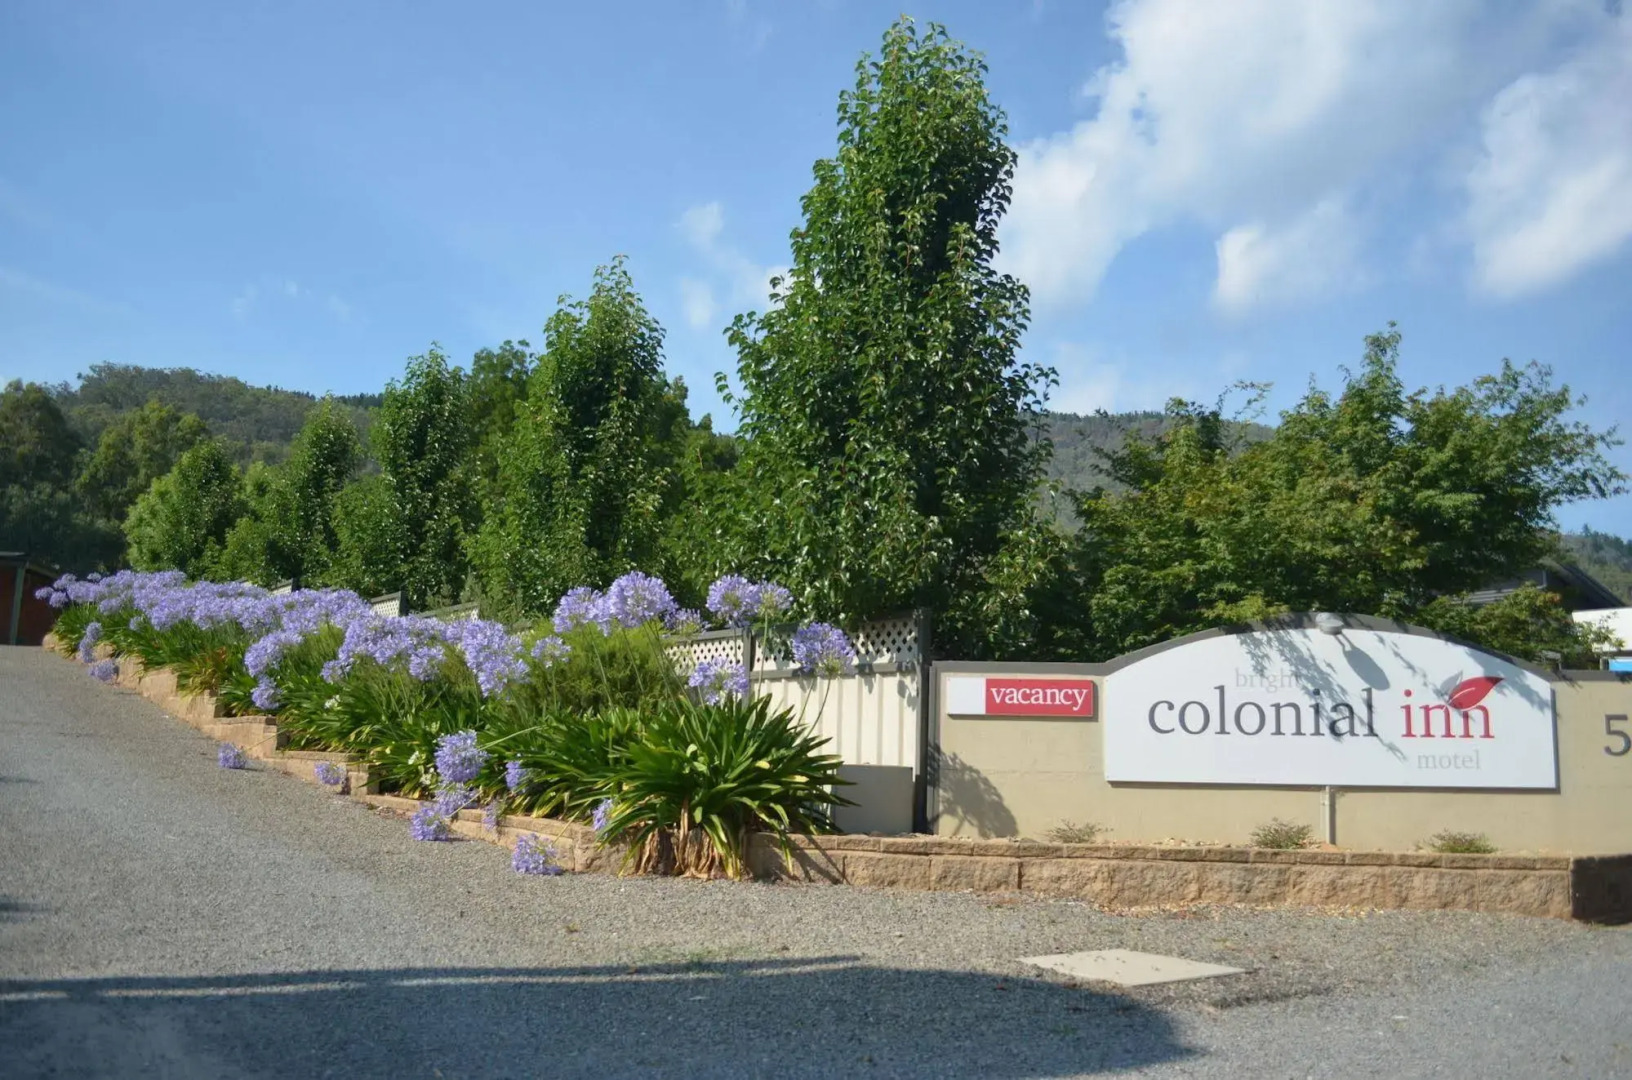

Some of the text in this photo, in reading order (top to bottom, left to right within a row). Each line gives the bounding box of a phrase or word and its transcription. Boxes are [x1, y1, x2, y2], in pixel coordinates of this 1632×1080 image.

[990, 686, 1088, 711] vacancy
[1148, 685, 1495, 739] colonial inn
[1604, 714, 1632, 756] 5
[1416, 750, 1481, 770] motel
